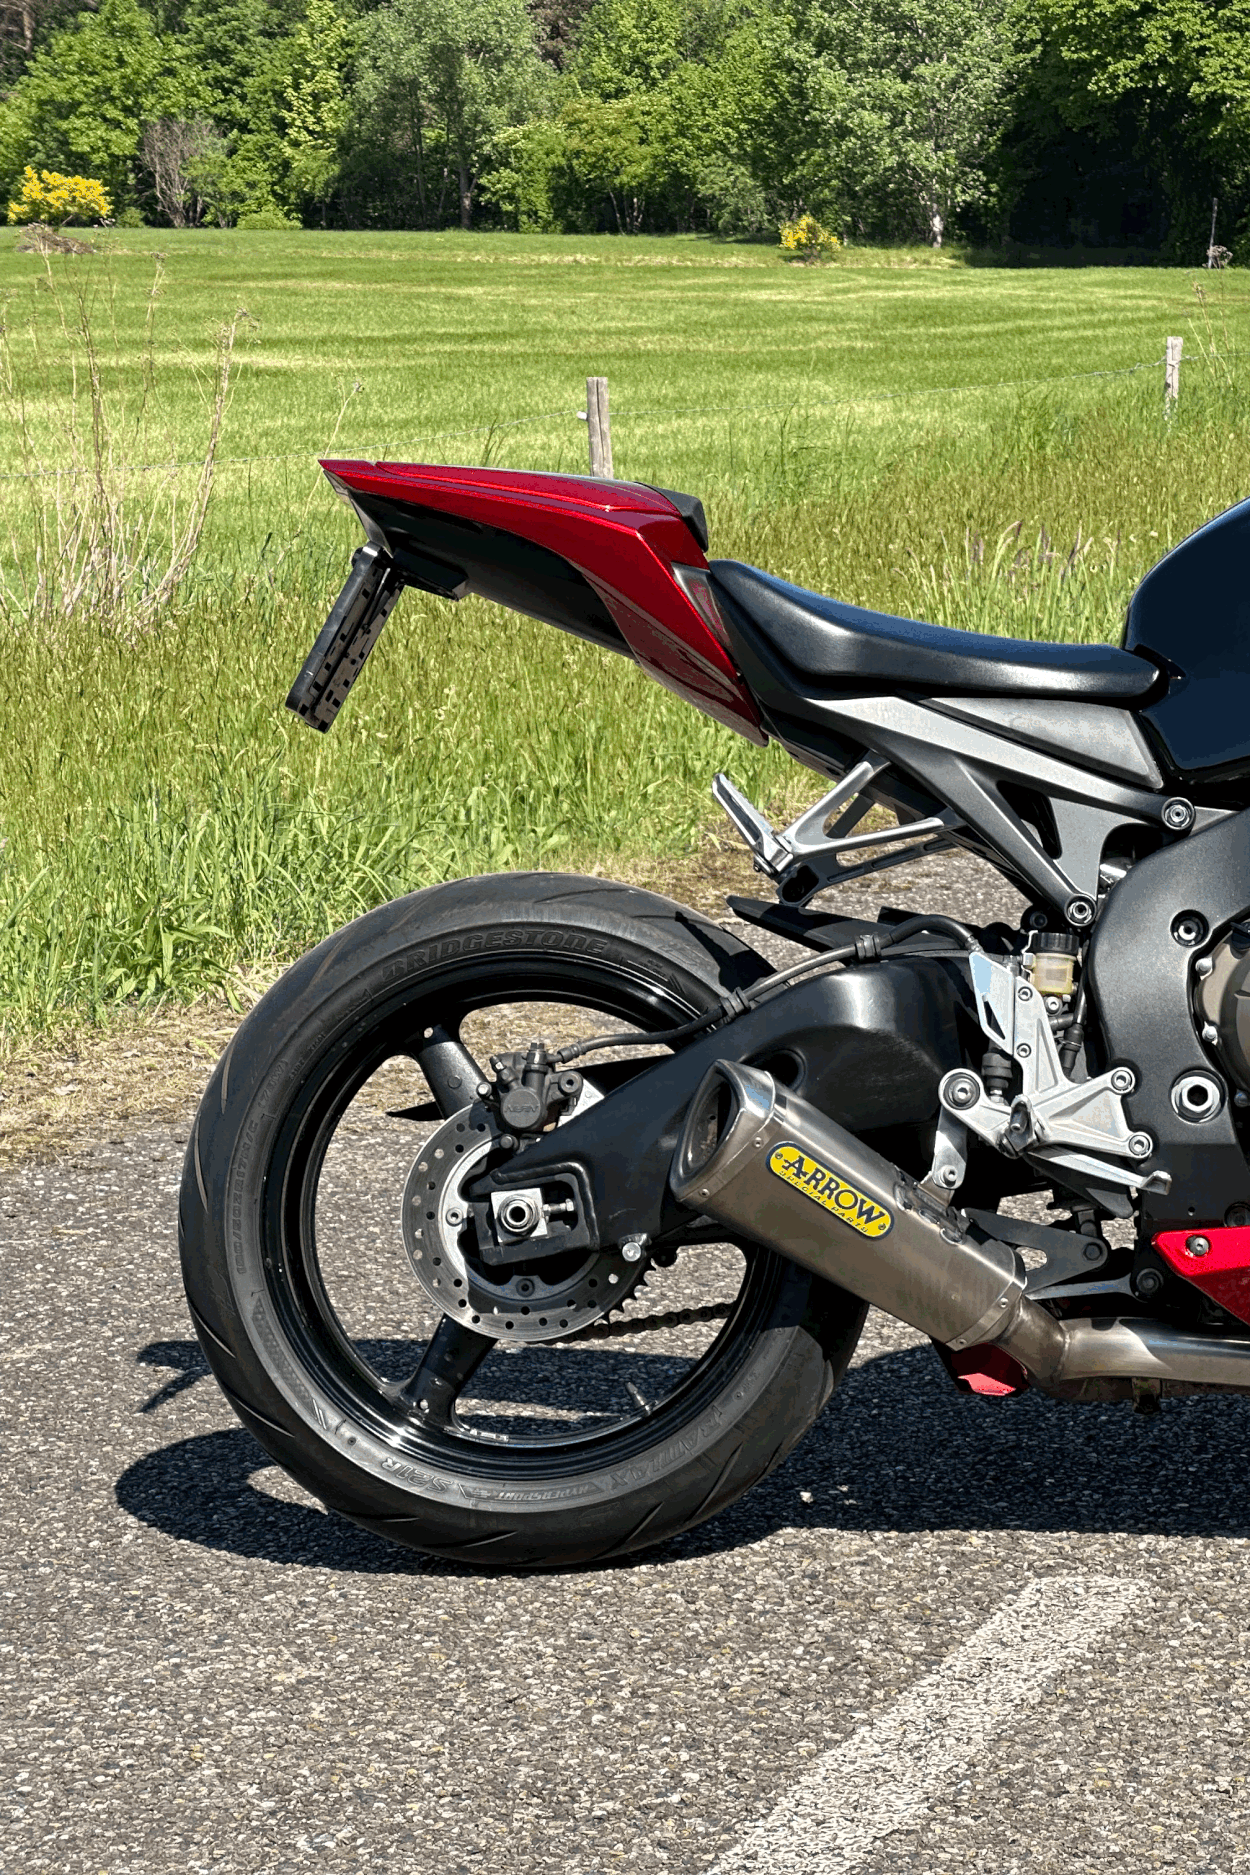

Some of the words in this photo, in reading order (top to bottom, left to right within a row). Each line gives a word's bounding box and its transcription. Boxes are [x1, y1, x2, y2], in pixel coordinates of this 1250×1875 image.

[383, 929, 609, 982] BRIDGESTONE
[779, 1170, 827, 1206] SPECIAL
[831, 1206, 868, 1233] PARTS
[782, 1155, 886, 1225] ARROW
[381, 1457, 453, 1494] S21R
